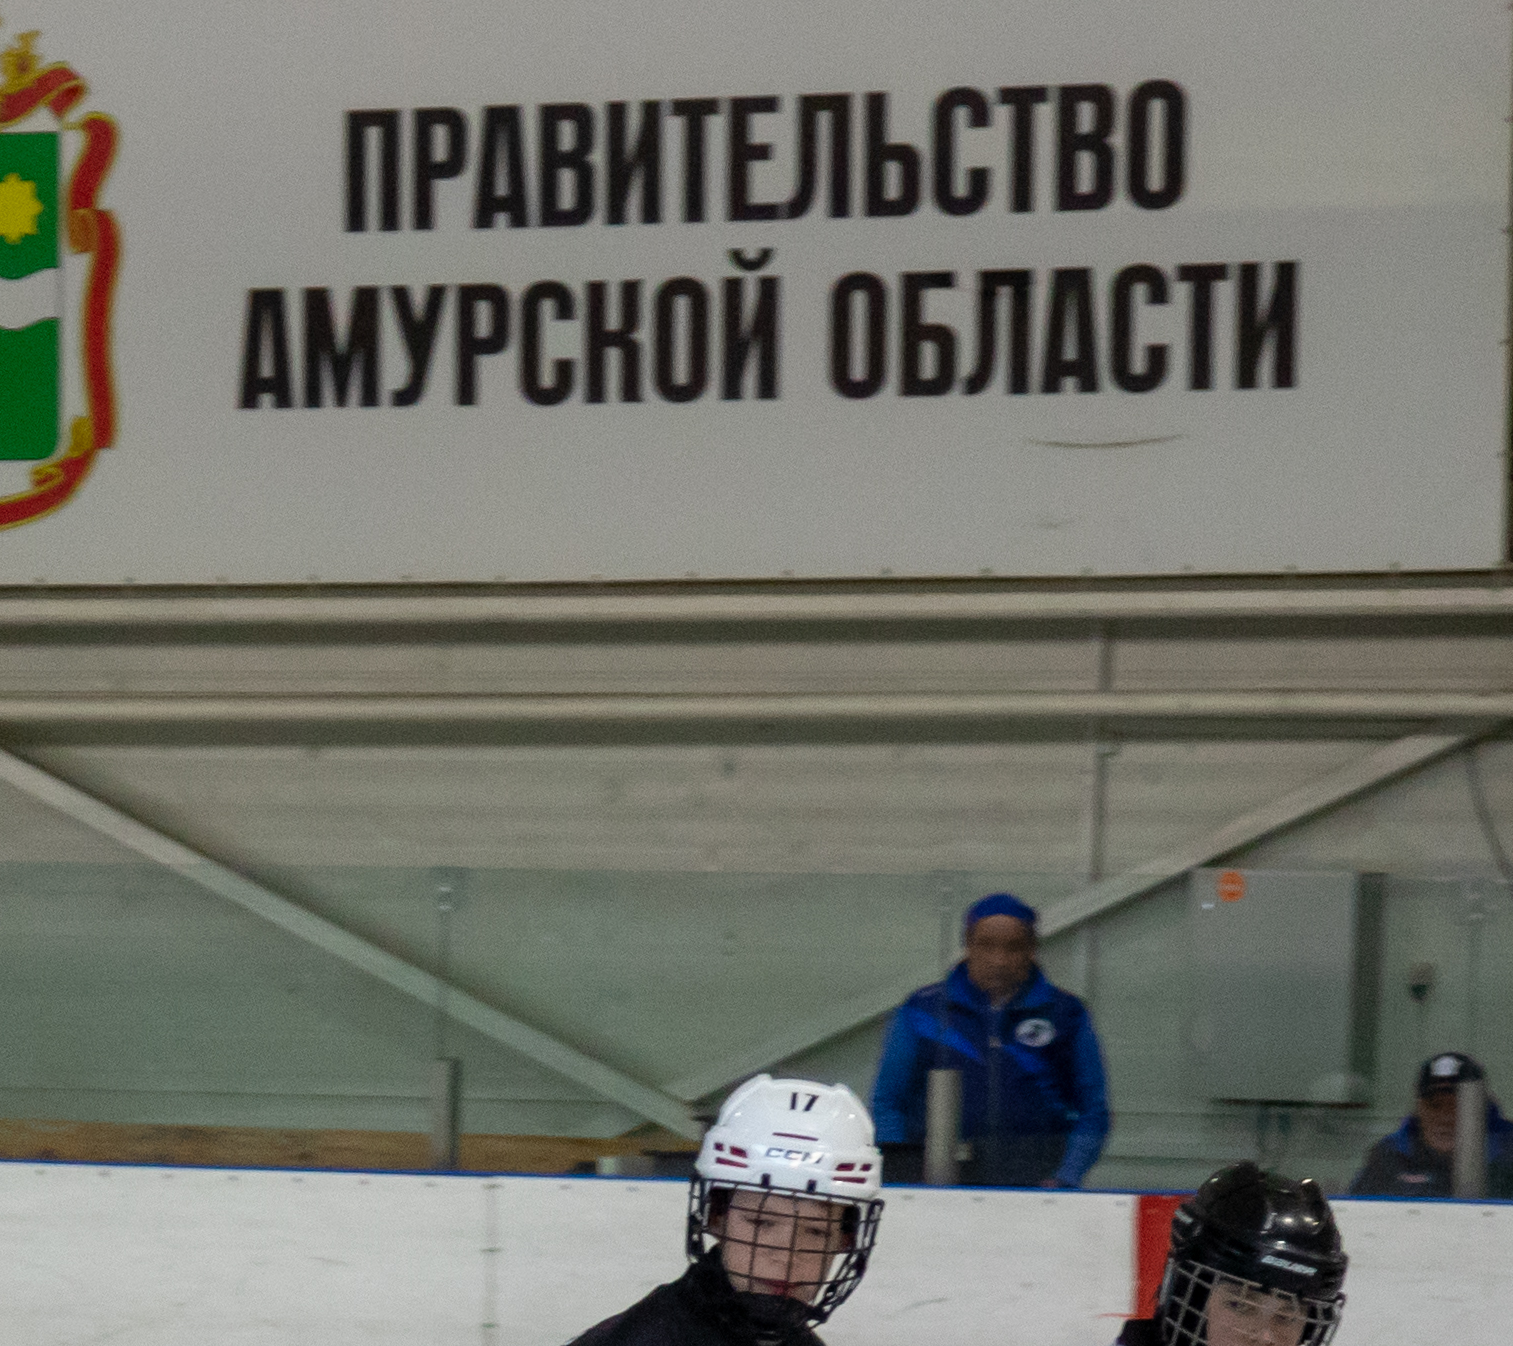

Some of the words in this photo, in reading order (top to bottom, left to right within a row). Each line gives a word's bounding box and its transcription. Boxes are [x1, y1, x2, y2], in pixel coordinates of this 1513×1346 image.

[343, 78, 1190, 233] ПРАВИТЕЛЬСТВО
[236, 247, 783, 410] АМУРСКОЙ
[827, 260, 1301, 400] ОБЛАСТИ
[789, 1092, 820, 1112] 17
